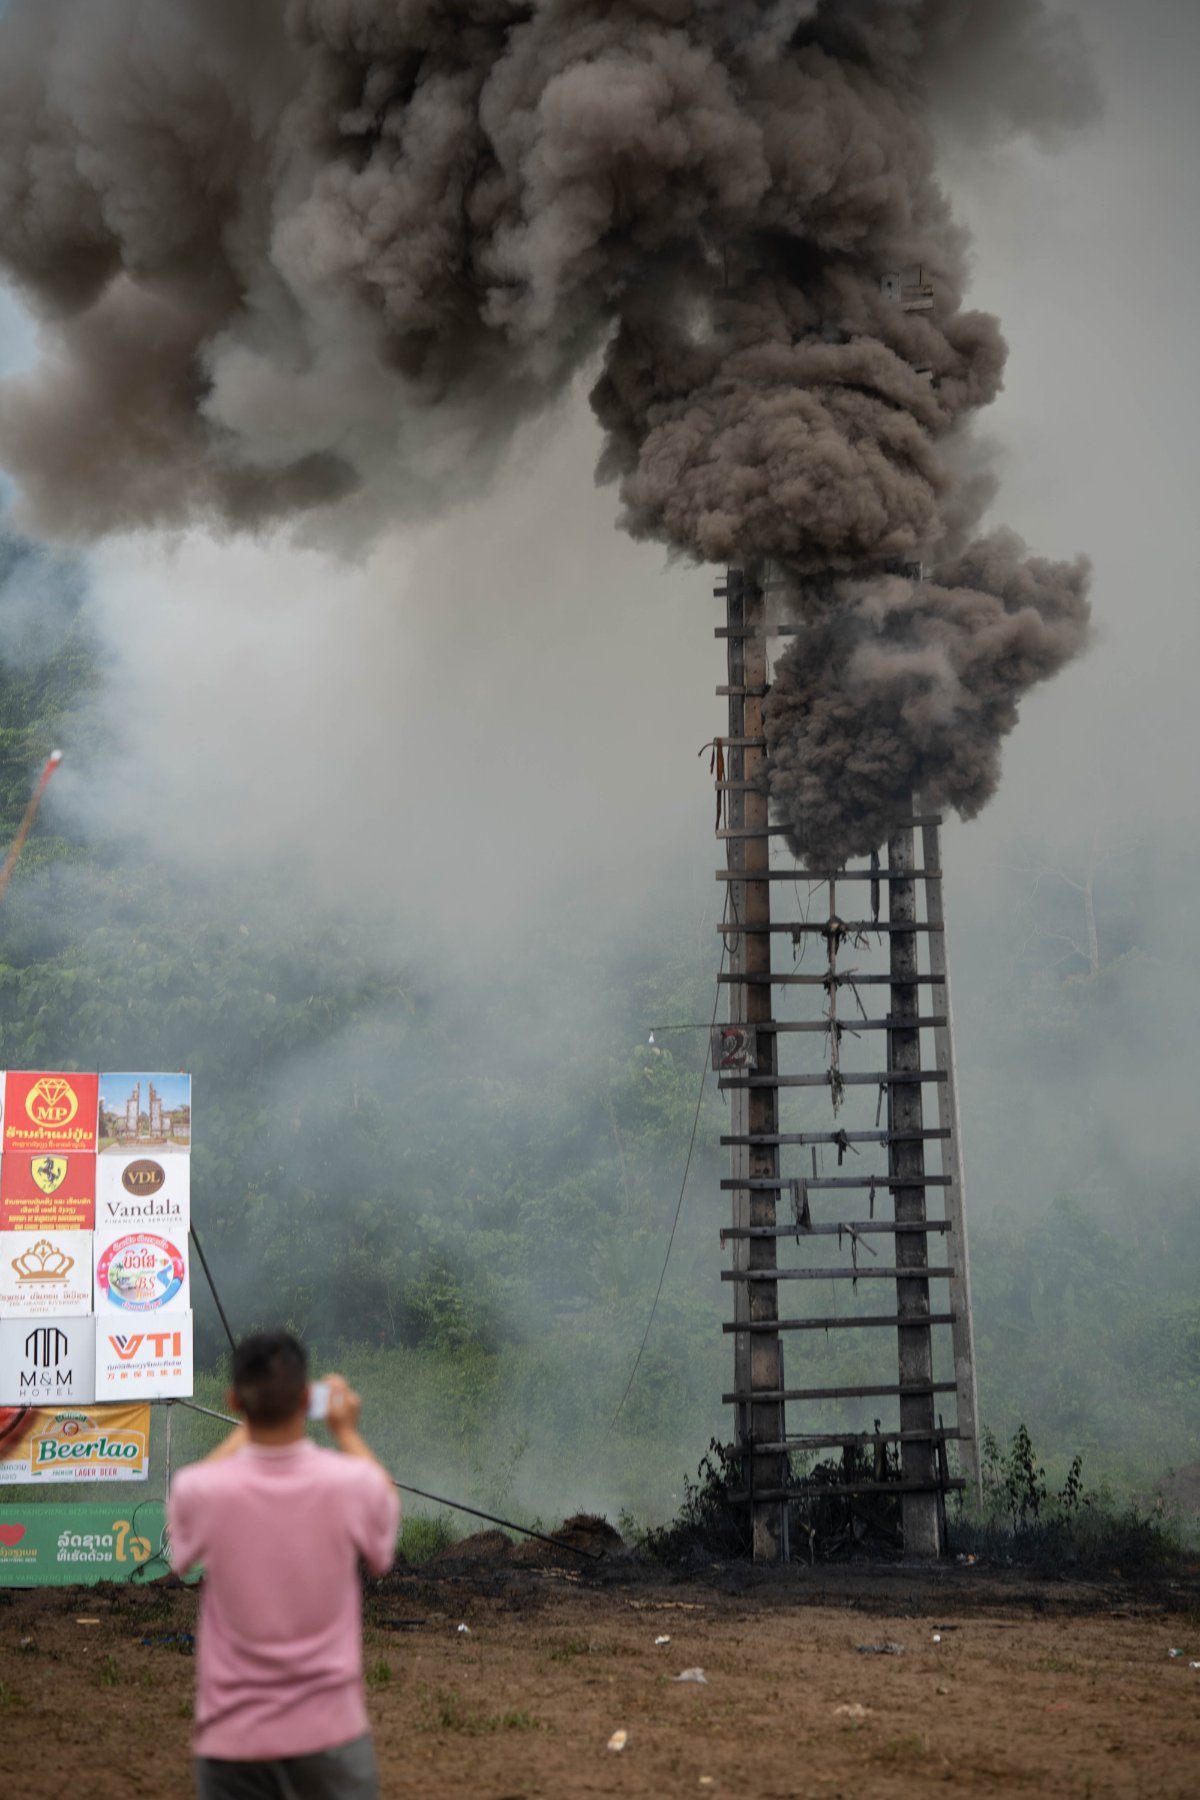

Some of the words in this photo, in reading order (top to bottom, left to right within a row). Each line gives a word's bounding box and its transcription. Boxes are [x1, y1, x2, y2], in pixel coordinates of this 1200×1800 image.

[721, 1027, 747, 1066] 2
[37, 1106, 68, 1120] MP
[127, 1171, 160, 1184] VDL
[107, 1199, 181, 1217] Vandala
[108, 1331, 181, 1359] VTI
[21, 1370, 71, 1386] M&M
[20, 1388, 73, 1397] HOTEL
[38, 1438, 137, 1460] Beerlao
[75, 1468, 96, 1477] LAGER
[100, 1467, 117, 1476] BEER
